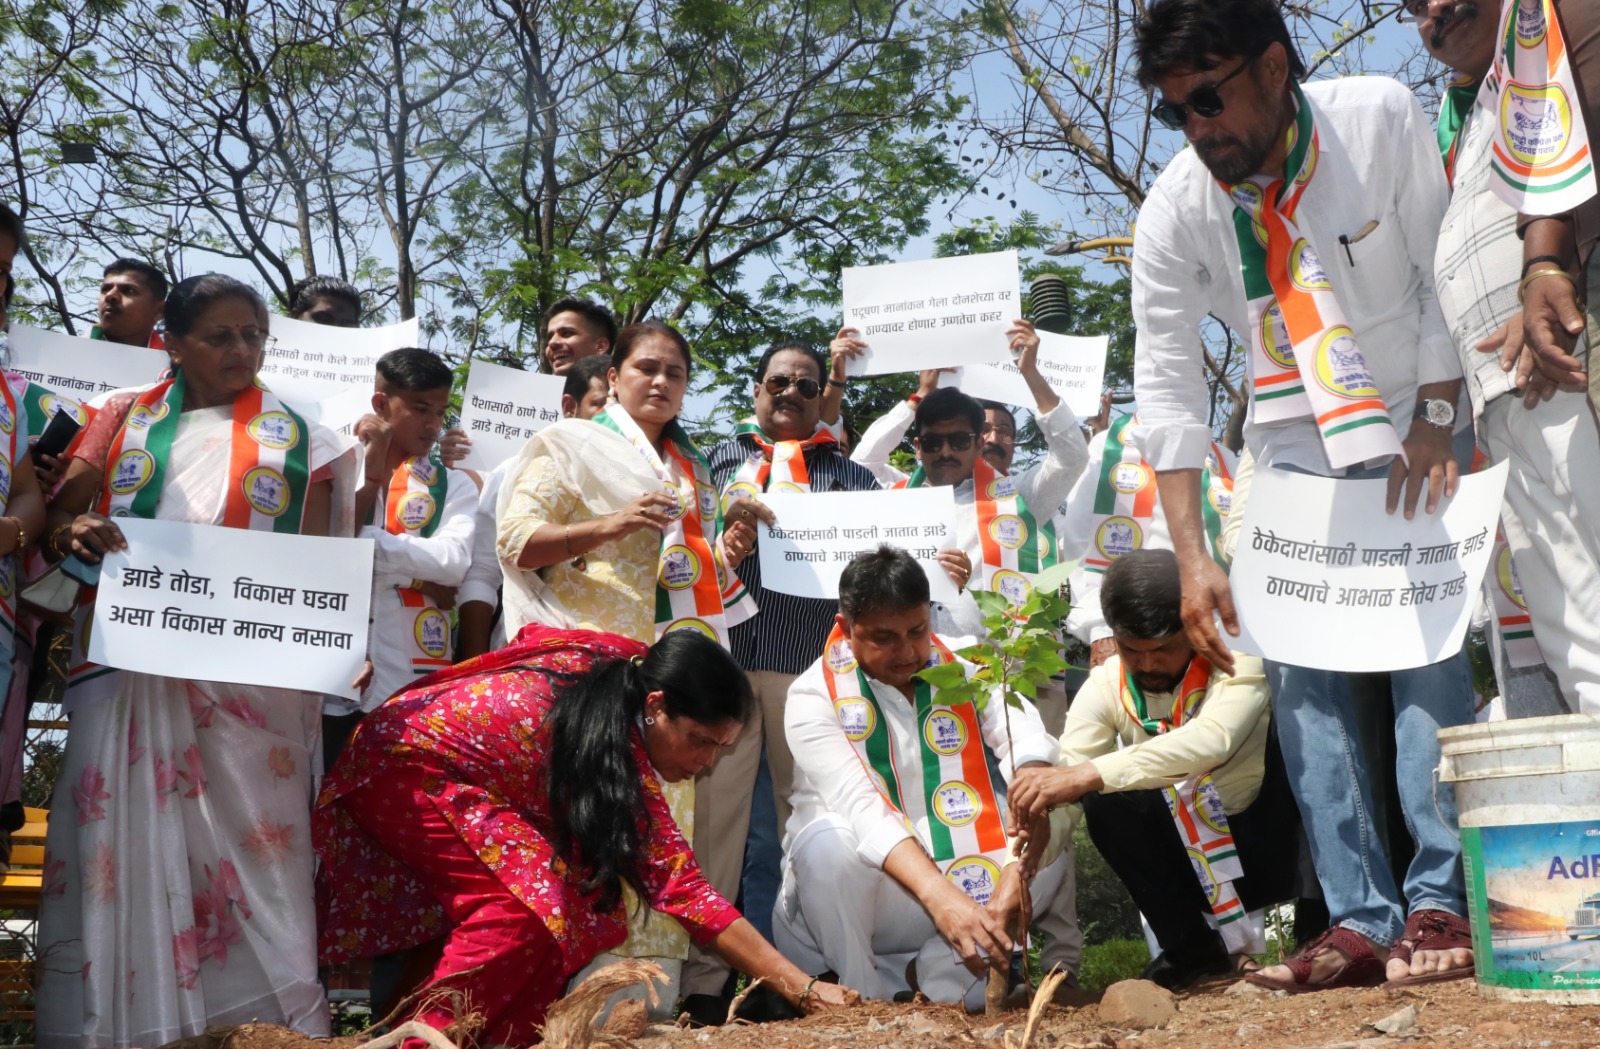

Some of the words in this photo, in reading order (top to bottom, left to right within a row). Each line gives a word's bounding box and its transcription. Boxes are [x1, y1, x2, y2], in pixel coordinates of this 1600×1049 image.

[883, 298, 925, 314] मानांकन
[928, 294, 949, 309] गेला
[997, 290, 1012, 302] वर
[865, 321, 905, 336] ठाण्यावर
[907, 316, 937, 331] होणार
[980, 310, 1003, 323] कहर
[304, 350, 324, 363] ठाणे
[328, 354, 348, 366] केले
[48, 374, 96, 392] मानांकन
[313, 372, 336, 382] कसा
[472, 394, 514, 414] पैशासाठी
[516, 406, 537, 419] ठाणे
[540, 408, 559, 422] केले
[471, 418, 492, 433] झाडे
[494, 422, 521, 440] तोडून
[842, 525, 878, 540] पाडली
[882, 526, 918, 539] जातात
[924, 522, 947, 538] झाडे
[784, 548, 827, 563] ठाण्याचे
[913, 546, 938, 560] उघडे
[1252, 526, 1357, 567] ठेकेदारांसाठी
[1362, 542, 1413, 568] पाडली
[1416, 541, 1460, 566] जातात
[1462, 526, 1488, 559] झाडे
[122, 564, 163, 590] झाडे
[170, 570, 216, 600] तोडा,
[232, 576, 294, 606] विकास
[302, 588, 349, 612] घडवा
[1266, 575, 1330, 605] ठाण्याचे
[1336, 586, 1396, 608] आभाळ
[1399, 581, 1438, 606] होतेय
[1440, 571, 1468, 600] उघडे
[108, 604, 155, 629] असा
[161, 608, 226, 638] विकास
[233, 618, 286, 643] मान्य
[292, 626, 354, 651] नसावा
